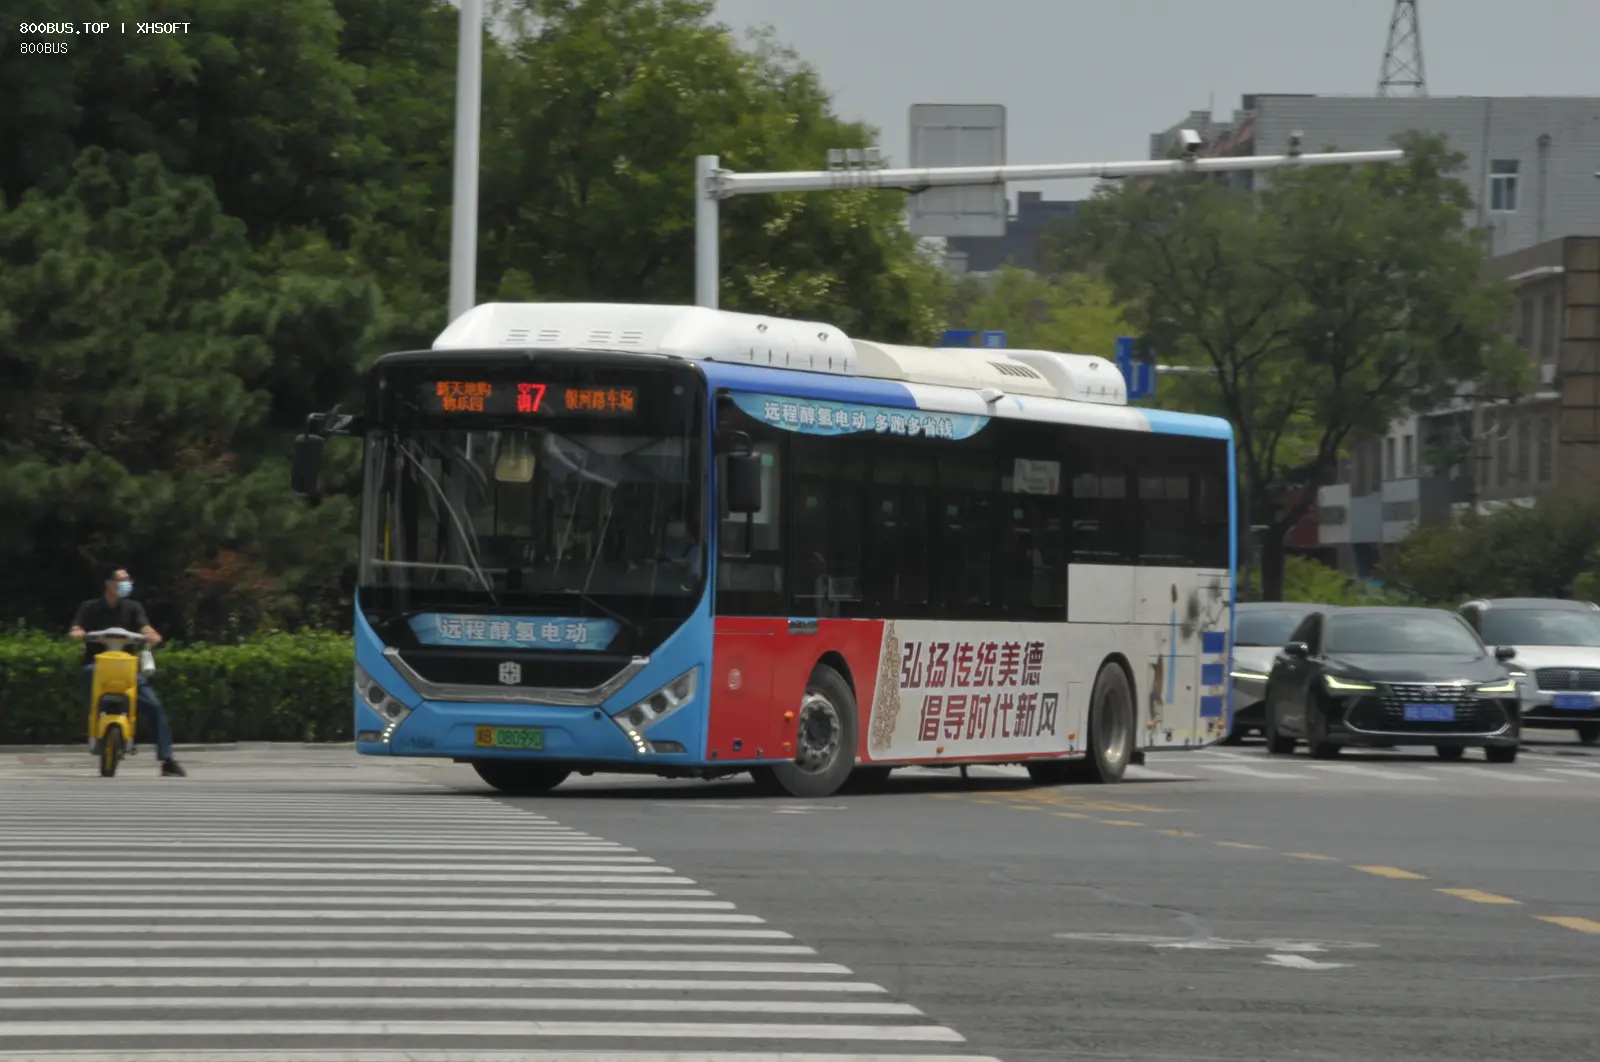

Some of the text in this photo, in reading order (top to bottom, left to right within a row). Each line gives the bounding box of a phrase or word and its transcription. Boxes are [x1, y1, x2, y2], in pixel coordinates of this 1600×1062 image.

[531, 384, 546, 412] 7
[763, 402, 954, 439] 远程醇氢电动 多跑多省钱
[441, 618, 588, 643] 远程醇氢电动
[900, 641, 1046, 689] 弘扬传统美德
[918, 692, 1060, 741] 倡导时代新风
